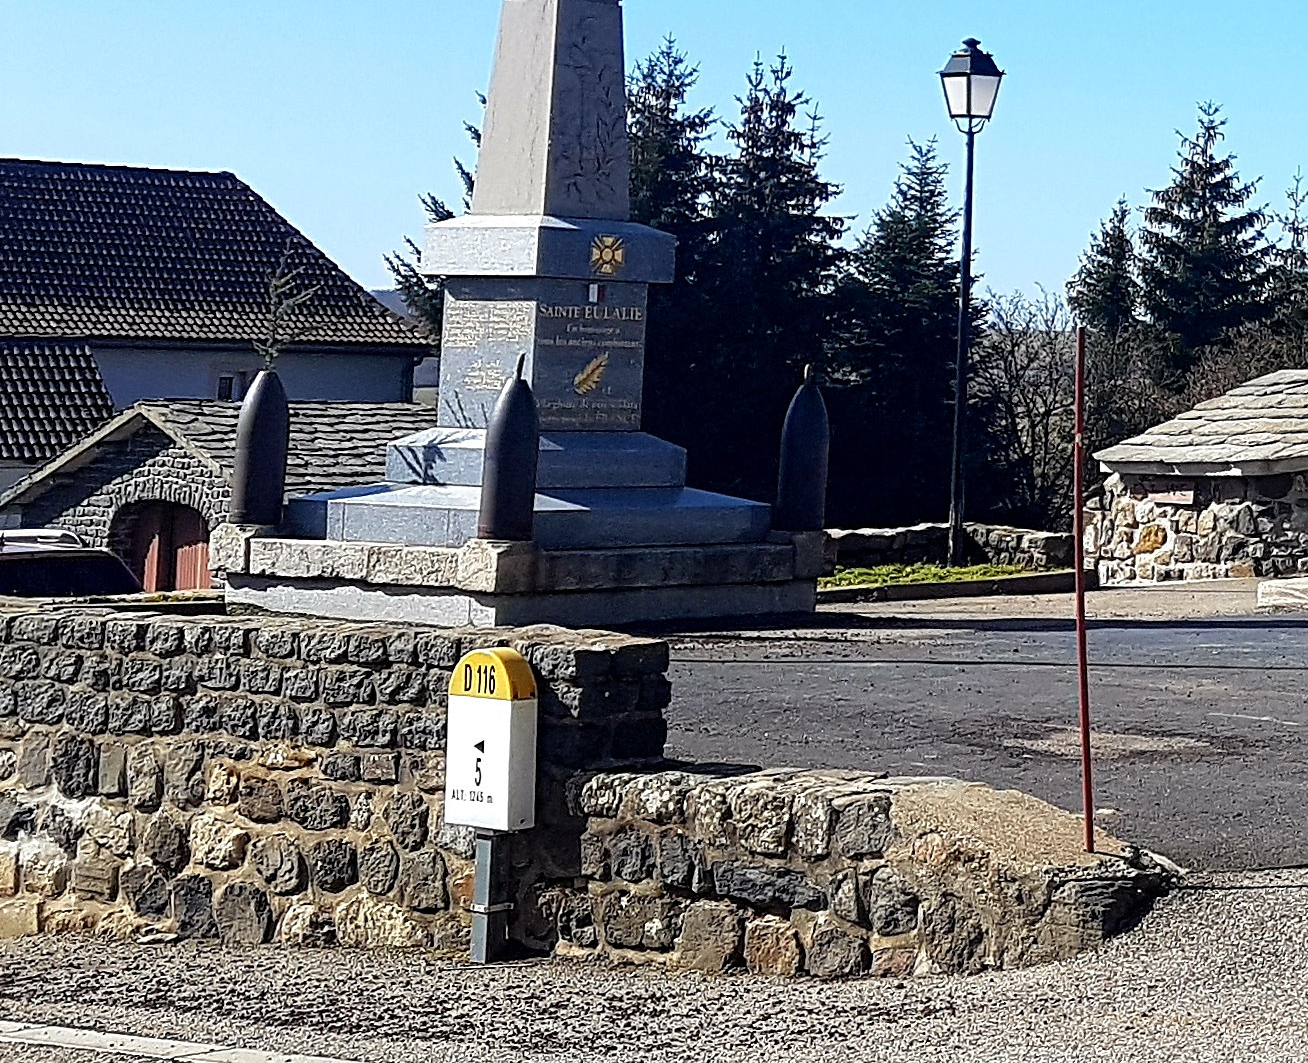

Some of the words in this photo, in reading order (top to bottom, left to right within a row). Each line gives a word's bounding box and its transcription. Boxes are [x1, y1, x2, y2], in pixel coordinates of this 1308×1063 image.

[539, 304, 582, 320] SAINTE
[584, 305, 643, 321] EULALIE
[464, 664, 473, 692] D
[476, 665, 496, 695] 116
[474, 757, 482, 787] 5
